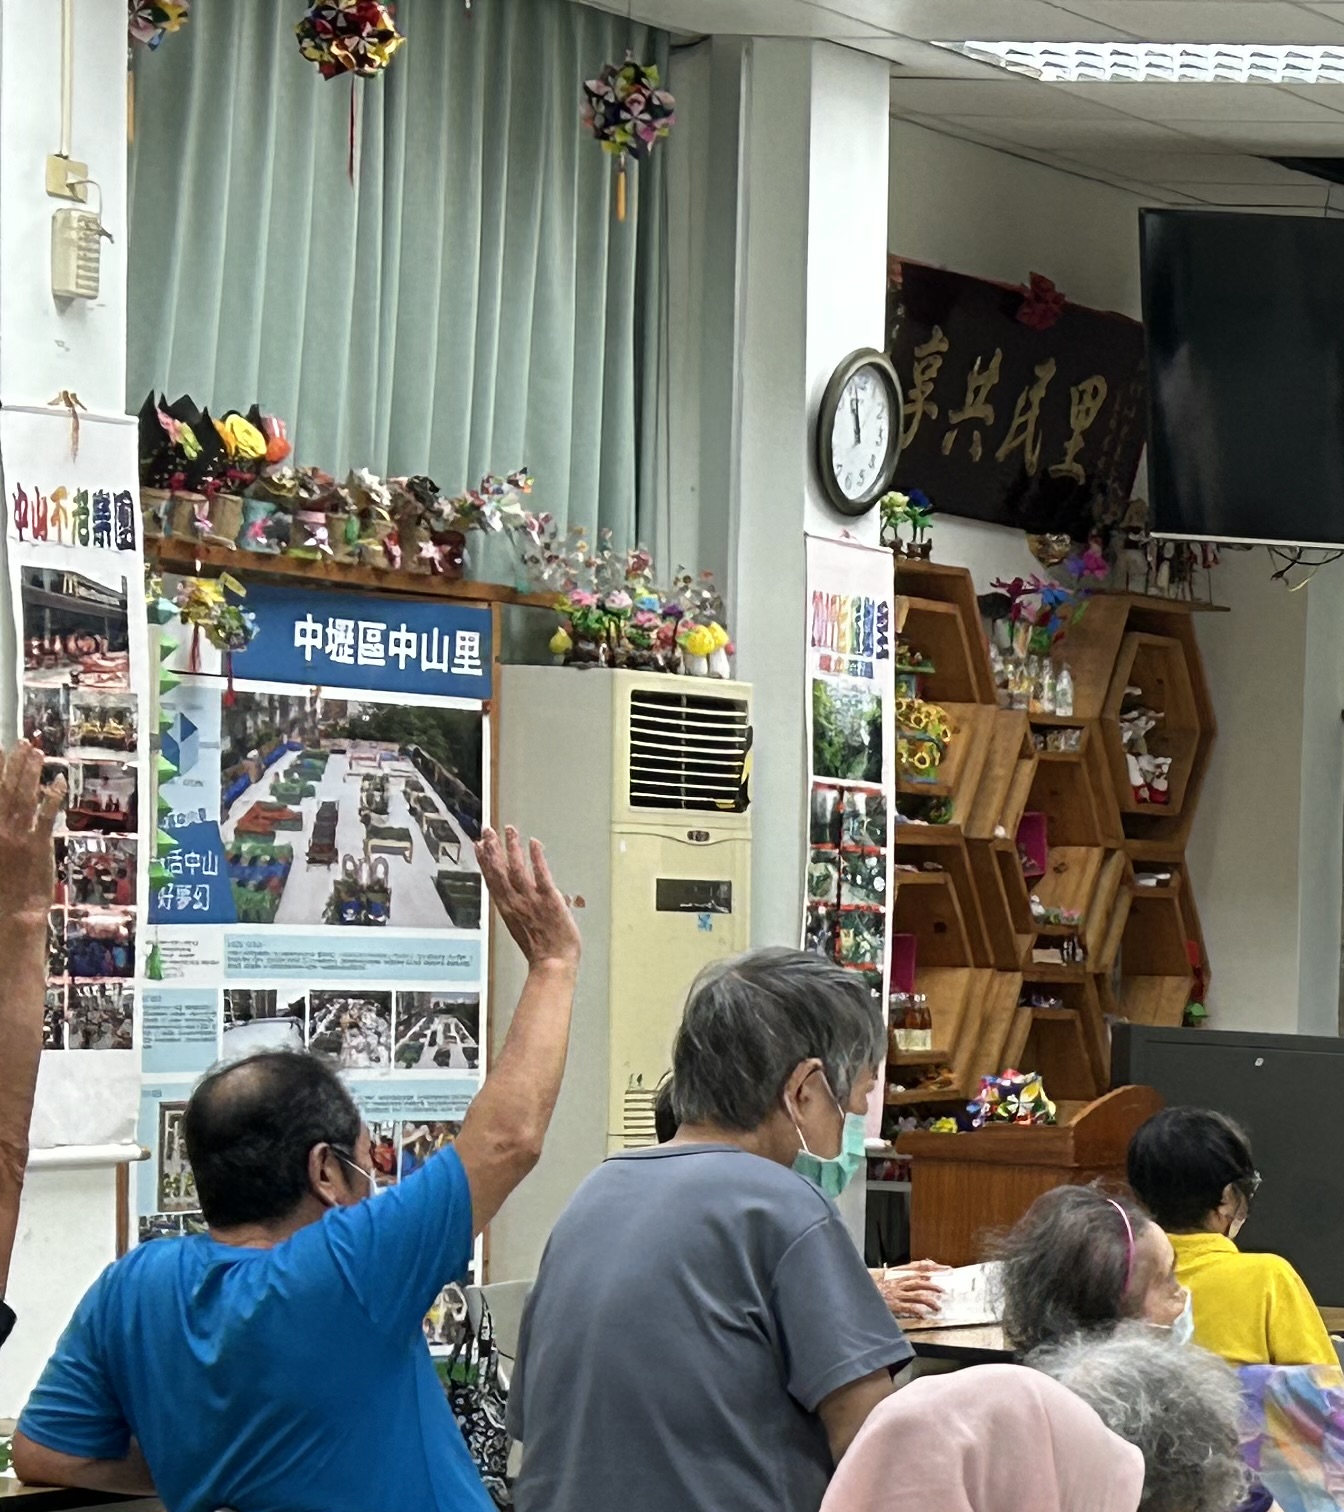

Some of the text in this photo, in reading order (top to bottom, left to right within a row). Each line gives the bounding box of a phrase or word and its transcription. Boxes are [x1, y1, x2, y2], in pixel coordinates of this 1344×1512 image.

[292, 612, 484, 676] 中壢區中山里
